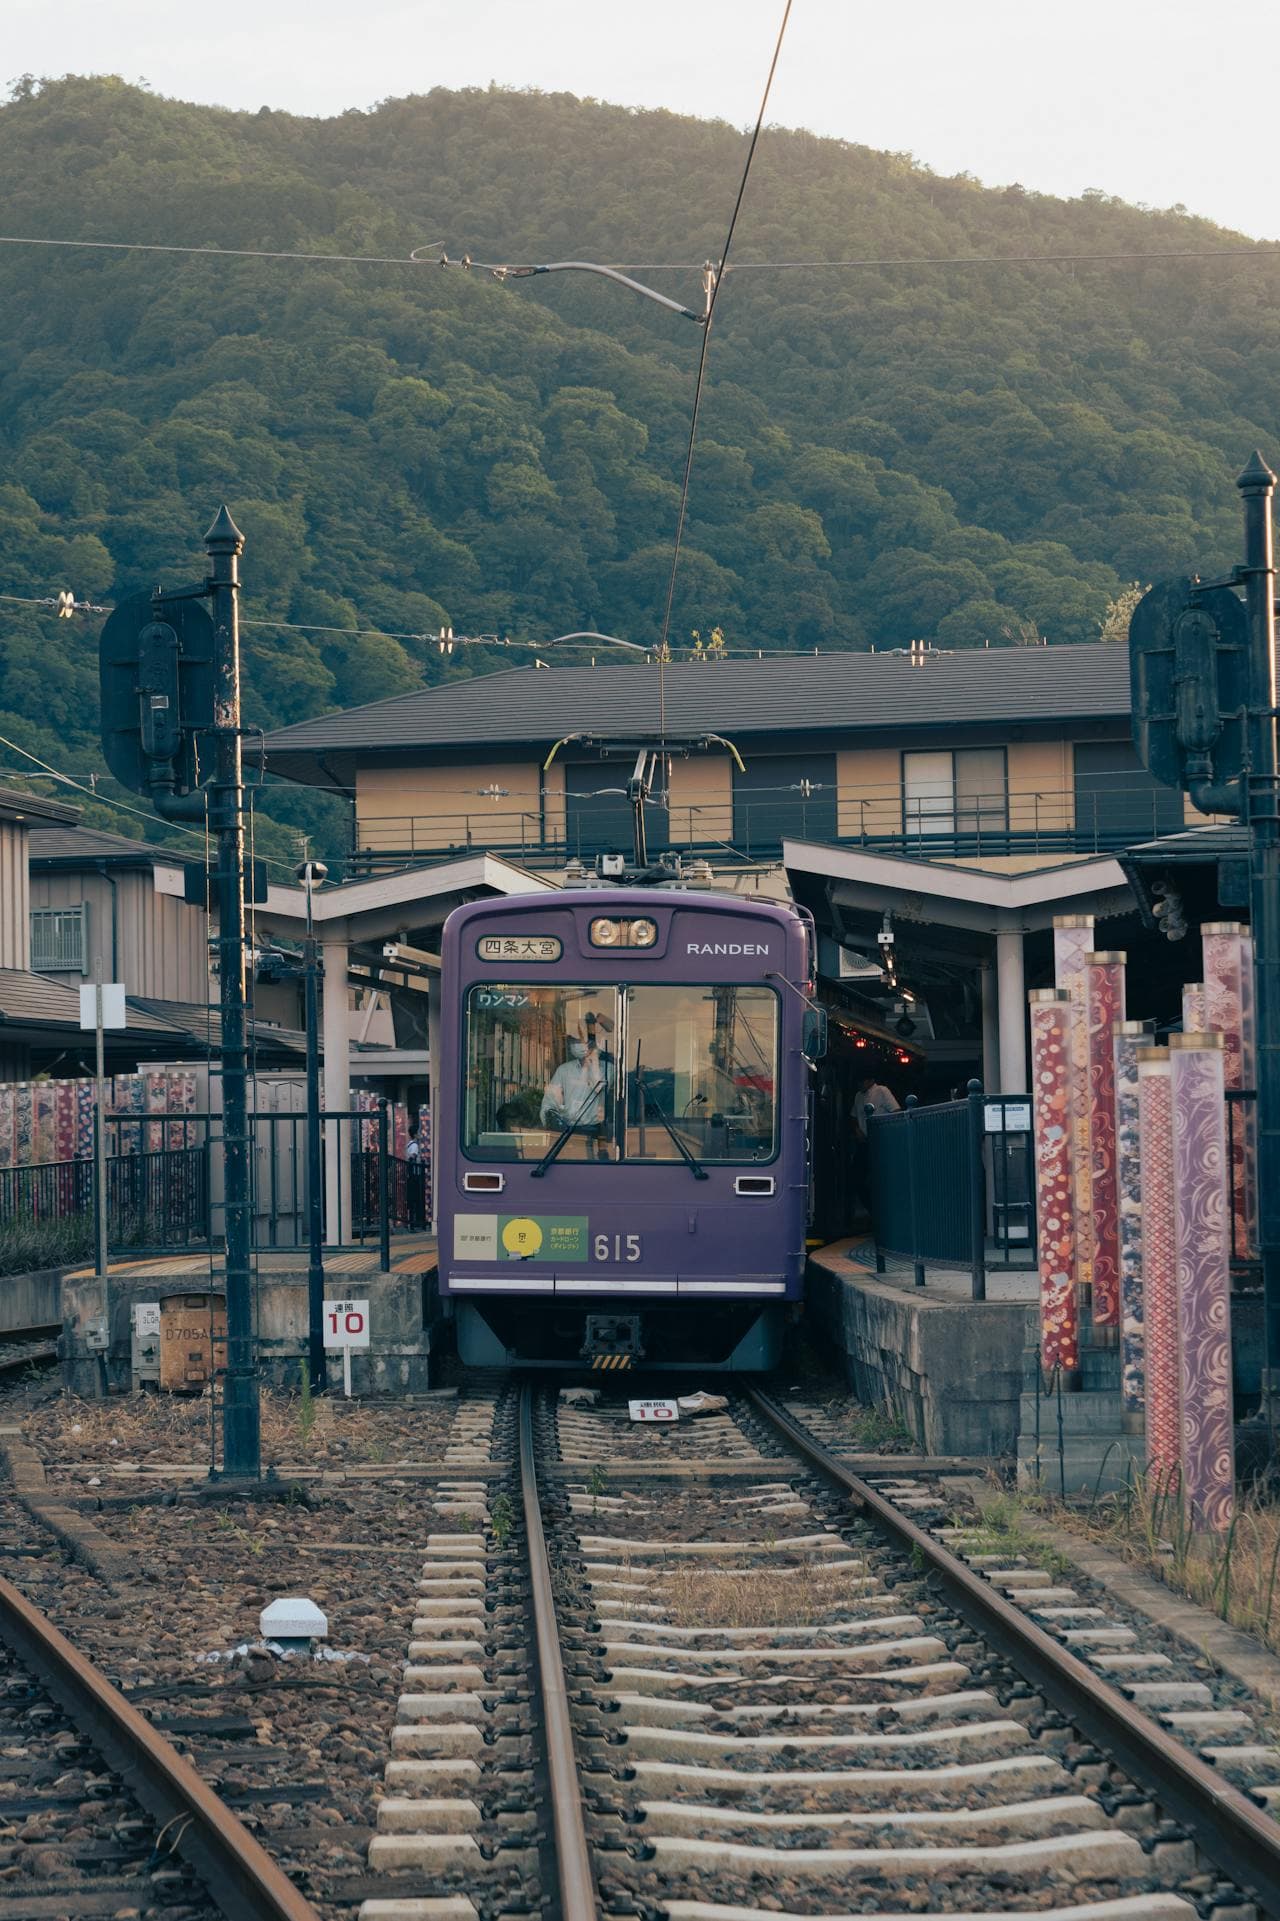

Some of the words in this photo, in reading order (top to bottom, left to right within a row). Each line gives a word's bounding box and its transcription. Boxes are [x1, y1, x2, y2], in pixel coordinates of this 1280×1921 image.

[485, 940, 556, 955] 四条大宮
[686, 943, 769, 955] RANDEN
[479, 994, 529, 1007] ワンマン
[594, 1234, 641, 1262] 615
[328, 1312, 364, 1334] 10
[636, 1408, 672, 1417] 10
